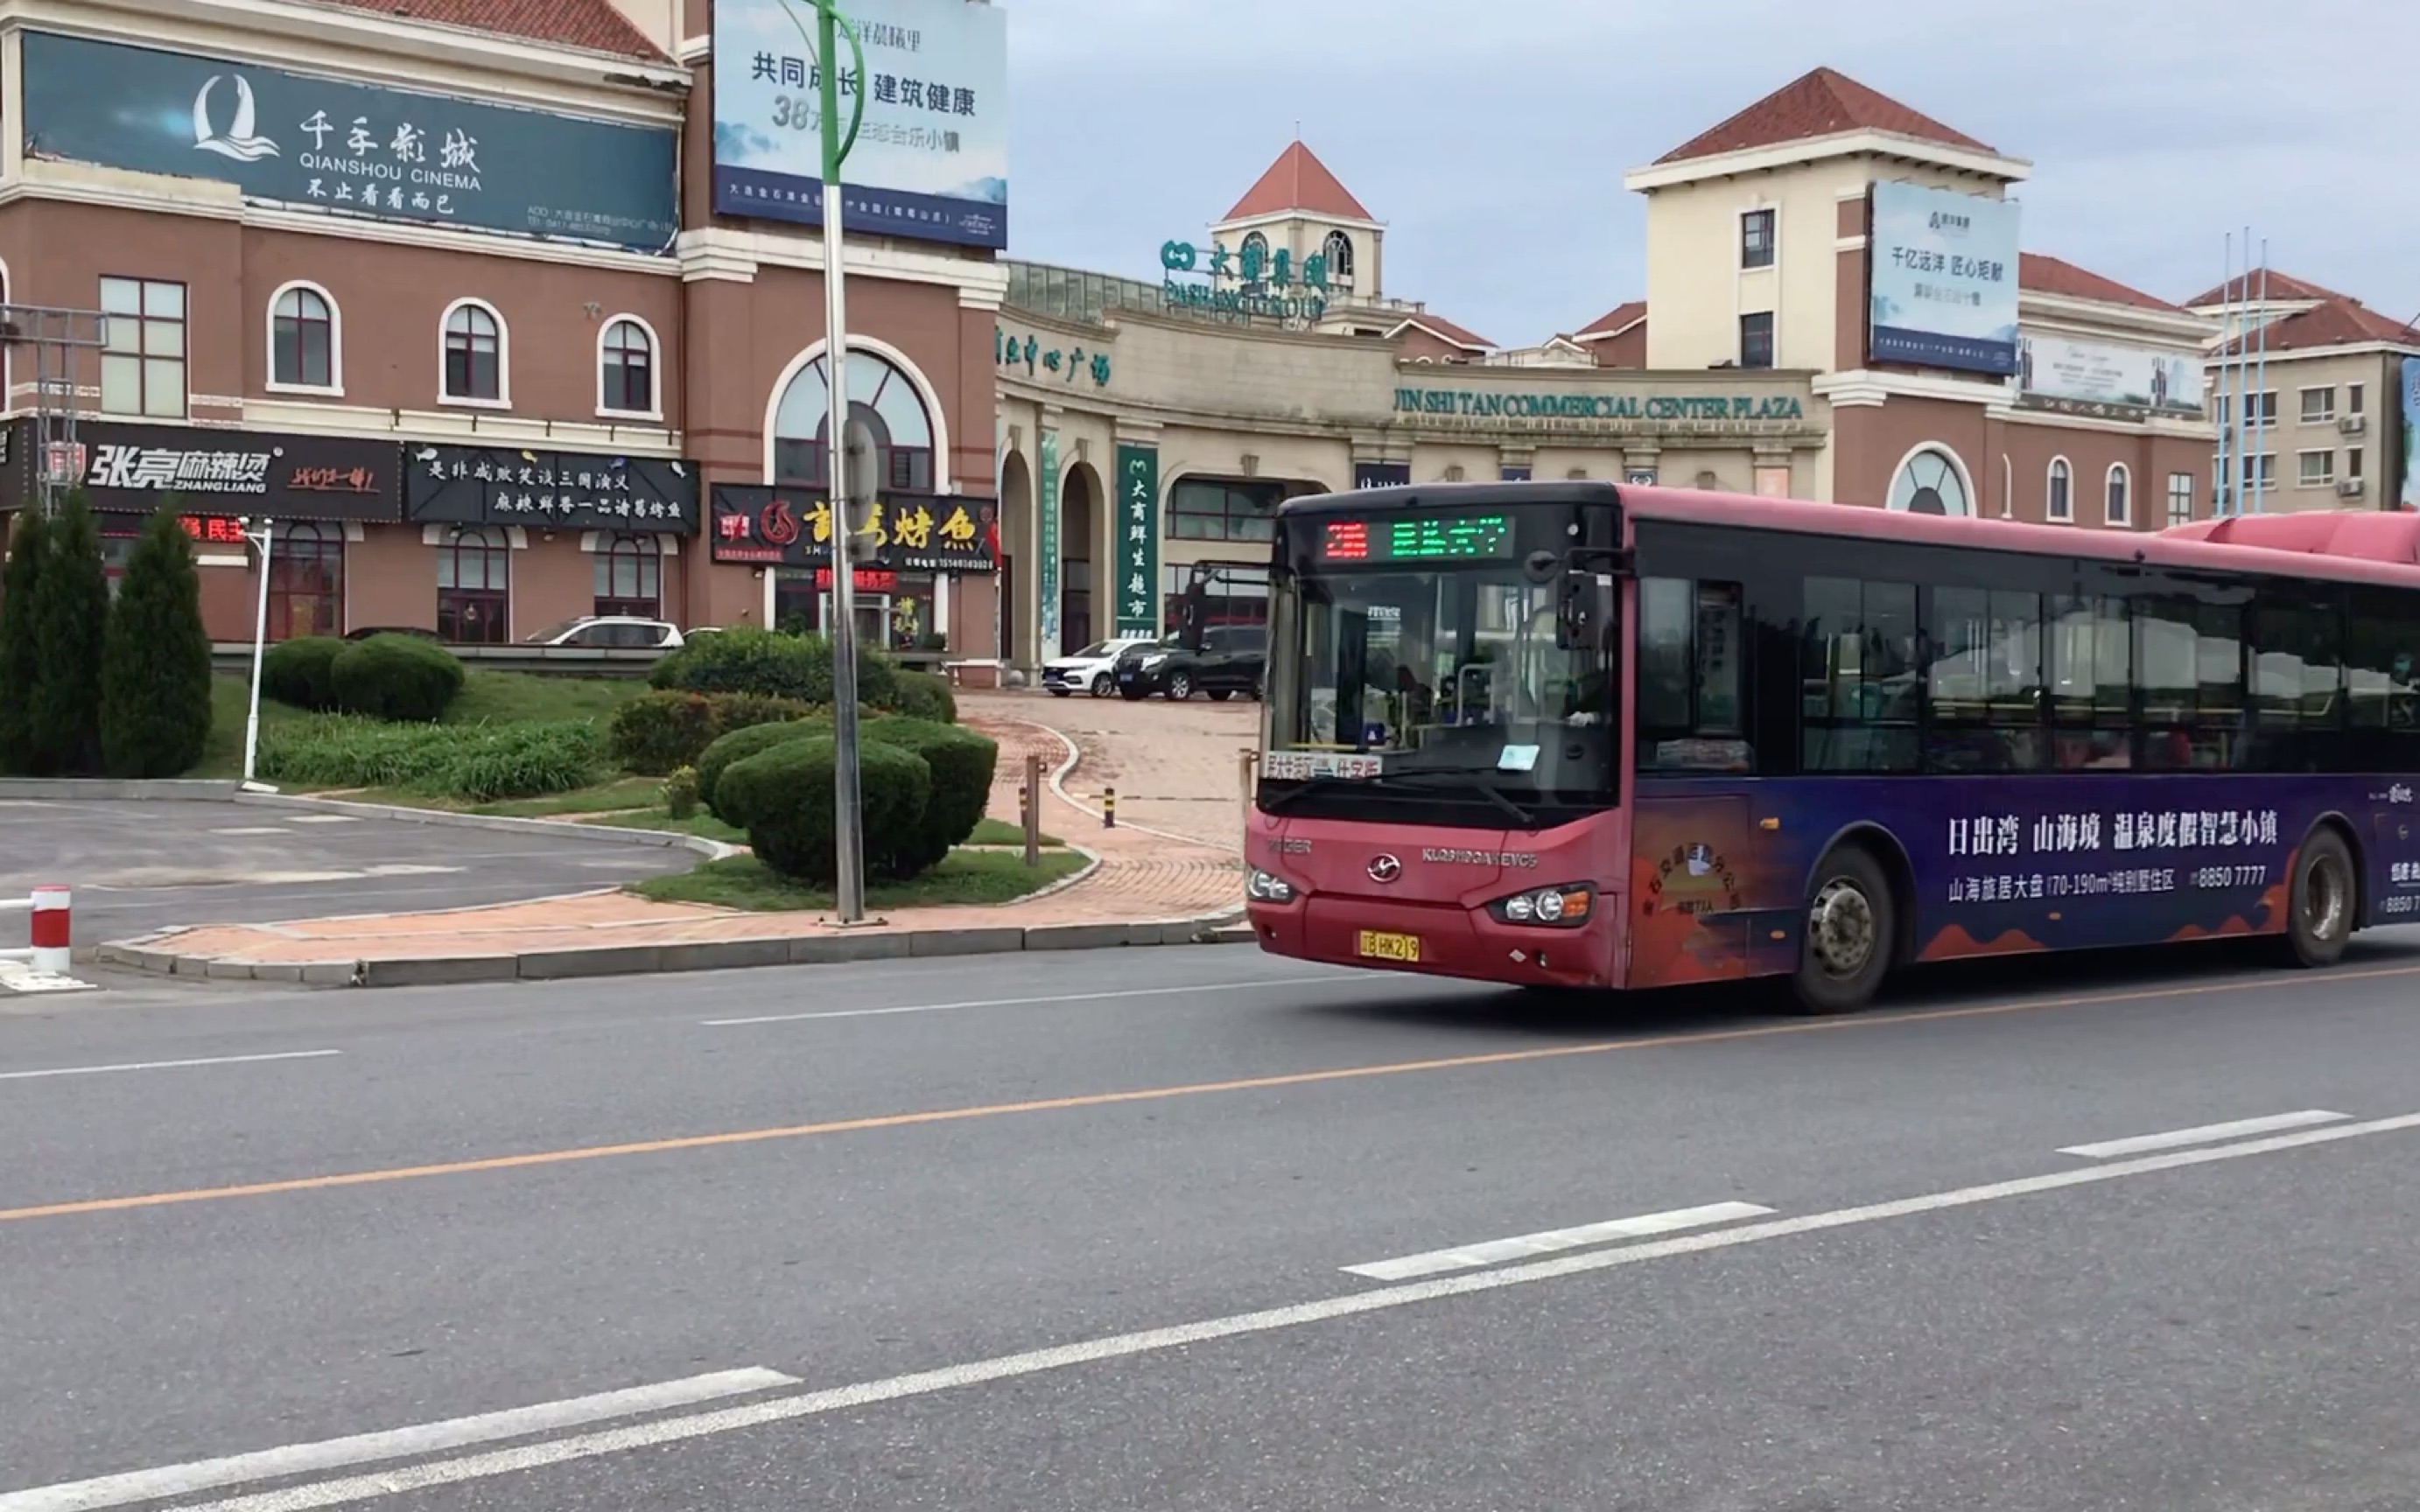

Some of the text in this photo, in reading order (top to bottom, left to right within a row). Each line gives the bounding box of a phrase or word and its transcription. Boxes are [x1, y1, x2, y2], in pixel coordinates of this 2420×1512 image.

[873, 73, 976, 116] 建筑健康
[299, 109, 480, 173] 千手影城
[299, 152, 481, 192] QIANSHOU CINEMA
[306, 178, 454, 215] 不止看看而已
[1645, 396, 1729, 419] CENTER
[1731, 396, 1803, 419] PLAZA
[88, 444, 270, 489] 张亮麻辣烫
[1128, 480, 1147, 618] 大商鲜生超市
[1948, 810, 2277, 855] 日出湾 山海境 温泉度假智慧小镇
[2199, 864, 2267, 888] 8850 7777
